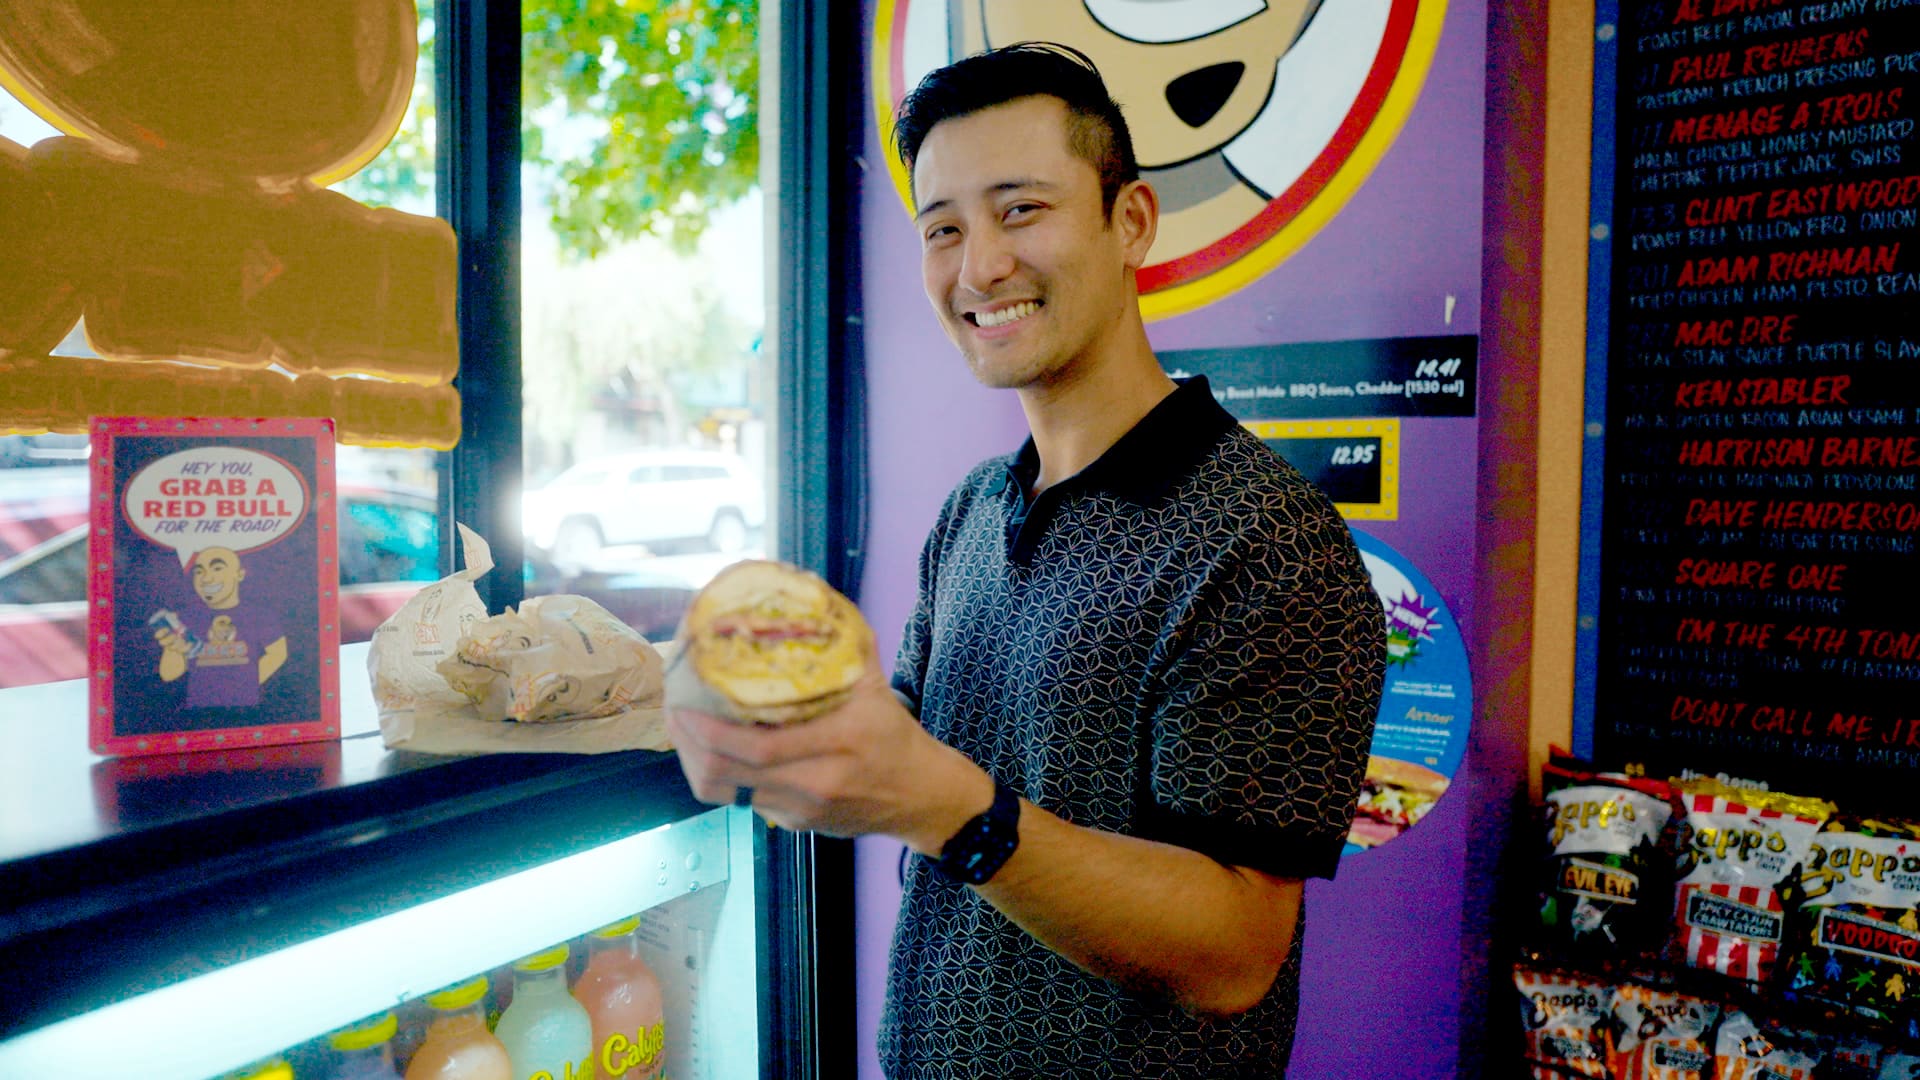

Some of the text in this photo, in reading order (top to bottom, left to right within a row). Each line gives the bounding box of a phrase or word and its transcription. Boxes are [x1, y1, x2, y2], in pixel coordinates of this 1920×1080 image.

[1668, 50, 1735, 86] PAUL
[1742, 26, 1870, 76] REUBENS
[1722, 72, 1788, 97] FRENCH
[1668, 104, 1784, 144] MENAGE
[1789, 101, 1811, 130] A
[1816, 87, 1904, 126] TROIS
[1760, 128, 1822, 156] HONEY
[1850, 143, 1902, 168] SWISS
[1684, 191, 1763, 228] CLINT
[1676, 255, 1760, 289] ADAM
[1766, 241, 1901, 283] RICHMAN
[1876, 270, 1920, 296] REA
[1674, 318, 1735, 349] MAC
[1738, 312, 1801, 346] DRE
[1290, 383, 1317, 399] BBQ
[1356, 380, 1403, 396] Cheddar
[1674, 378, 1732, 409] KEN
[1732, 374, 1852, 408] STABLER
[1331, 446, 1376, 464] 12.95
[1677, 437, 1816, 468] HARRISON
[1820, 435, 1920, 469] BARNE
[181, 462, 252, 476] HEY YOU,
[159, 478, 277, 496] GRAB A
[143, 499, 292, 518] RED BULL
[1684, 498, 1759, 528] DAVE
[154, 519, 281, 533] FOR THE ROAD!
[1674, 556, 1777, 590] SQUARE
[1785, 562, 1850, 593] ONE
[1723, 620, 1777, 651] THE
[1783, 624, 1849, 656] 4TH
[1856, 628, 1920, 662] TON
[1751, 704, 1815, 738] CALL
[1825, 711, 1874, 743] ME
[1564, 864, 1633, 898] EVIL EYE
[1891, 874, 1920, 883] POTAT
[1823, 918, 1918, 960] VOODOO
